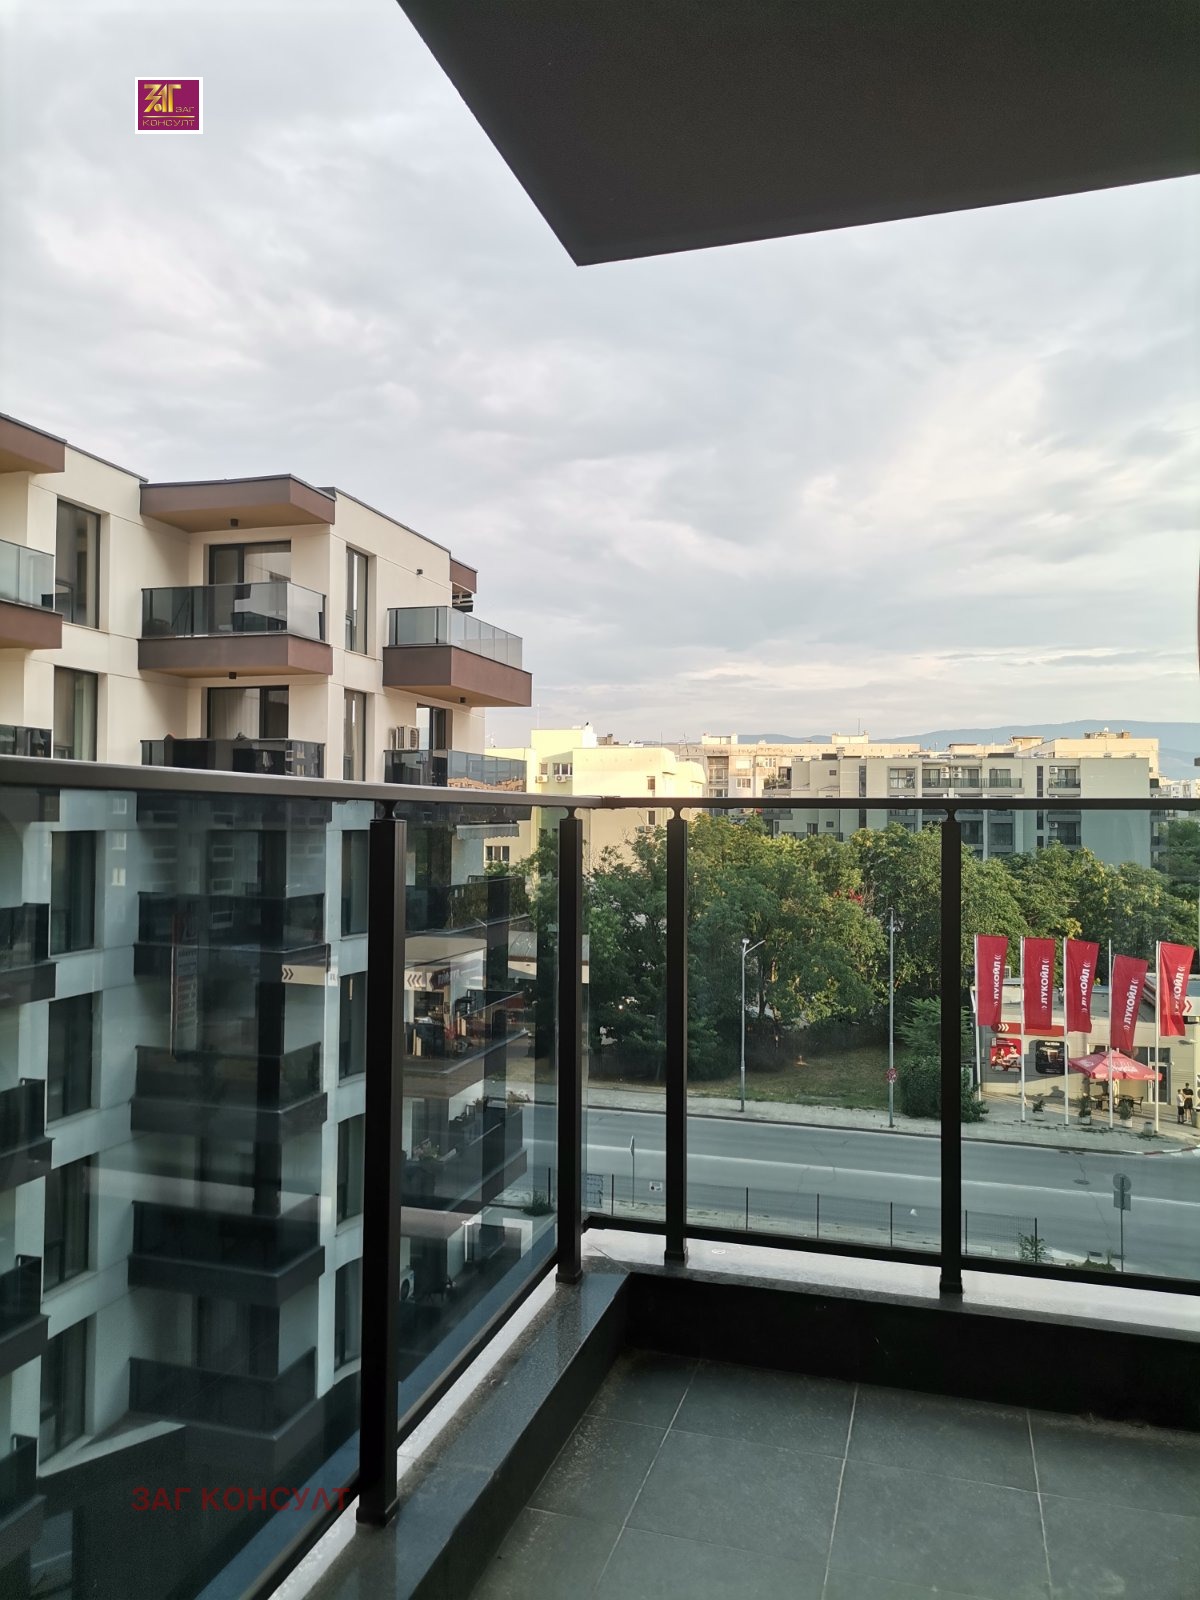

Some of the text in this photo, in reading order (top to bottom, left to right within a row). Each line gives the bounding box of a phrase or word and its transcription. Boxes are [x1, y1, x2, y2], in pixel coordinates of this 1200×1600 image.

[1040, 965, 1050, 1005] ЛУКОЙЛ
[1124, 985, 1139, 1025] ЛУКОЙЛ
[1173, 972, 1185, 1010] КОЙЛ
